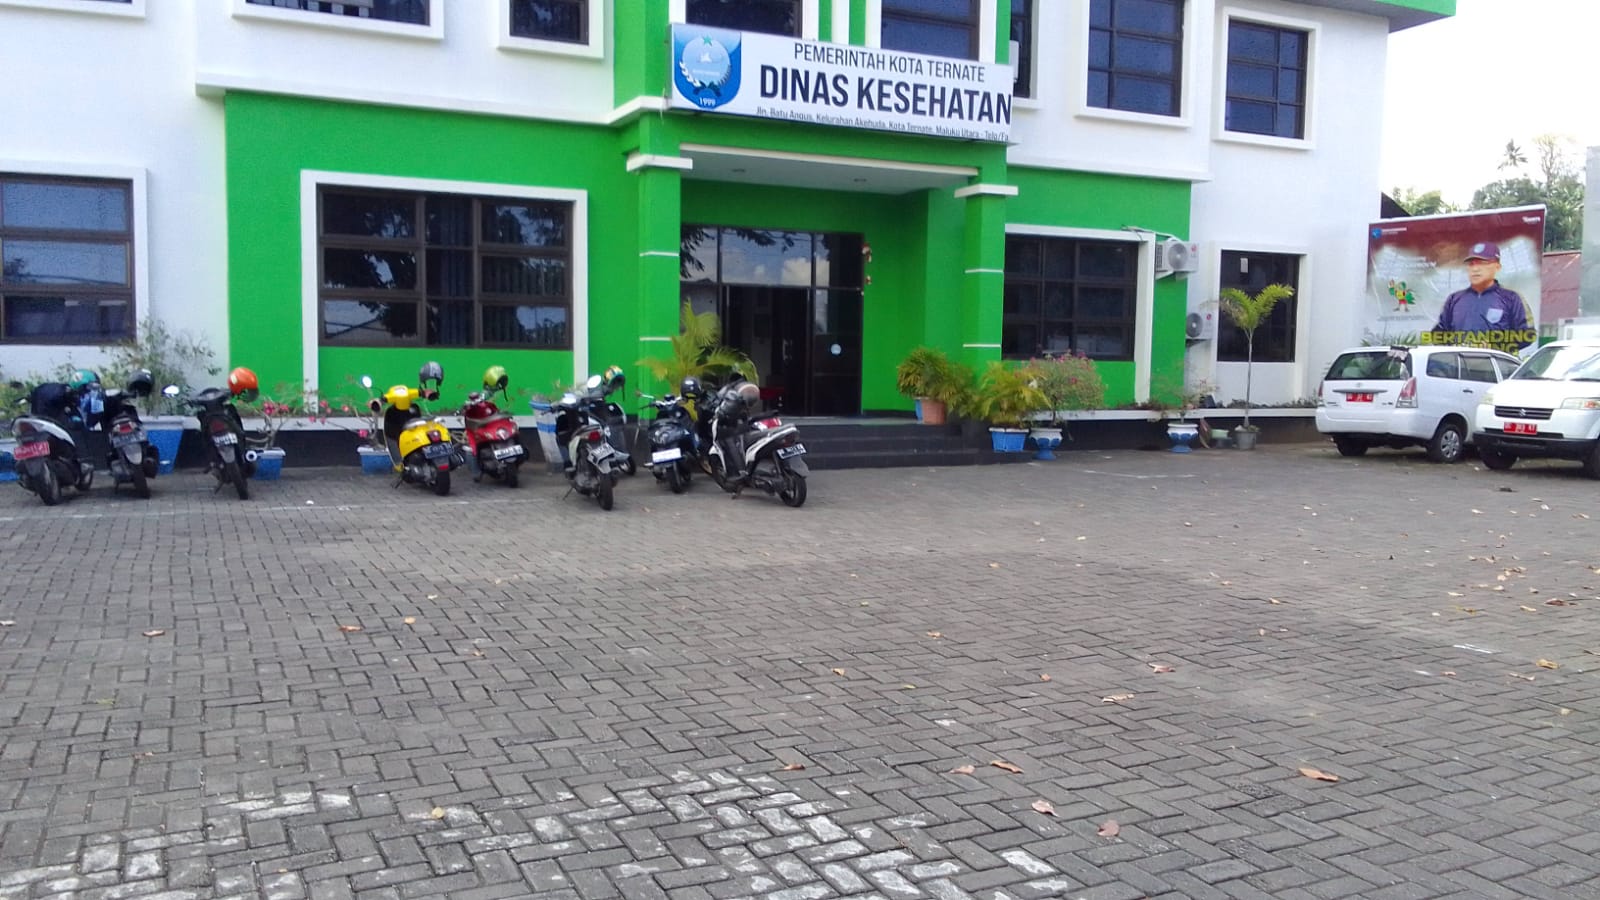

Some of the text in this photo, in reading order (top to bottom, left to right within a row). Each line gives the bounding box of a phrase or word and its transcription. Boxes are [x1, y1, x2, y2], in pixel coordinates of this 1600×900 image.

[794, 42, 986, 83] PEMERINTAH KOTA TERNATE
[760, 64, 1012, 125] DINAS KESEHATAN
[816, 112, 853, 126] Kelurahan
[889, 120, 906, 130] Kota
[936, 125, 960, 136] Maluku
[1421, 329, 1537, 345] BERTANDING
